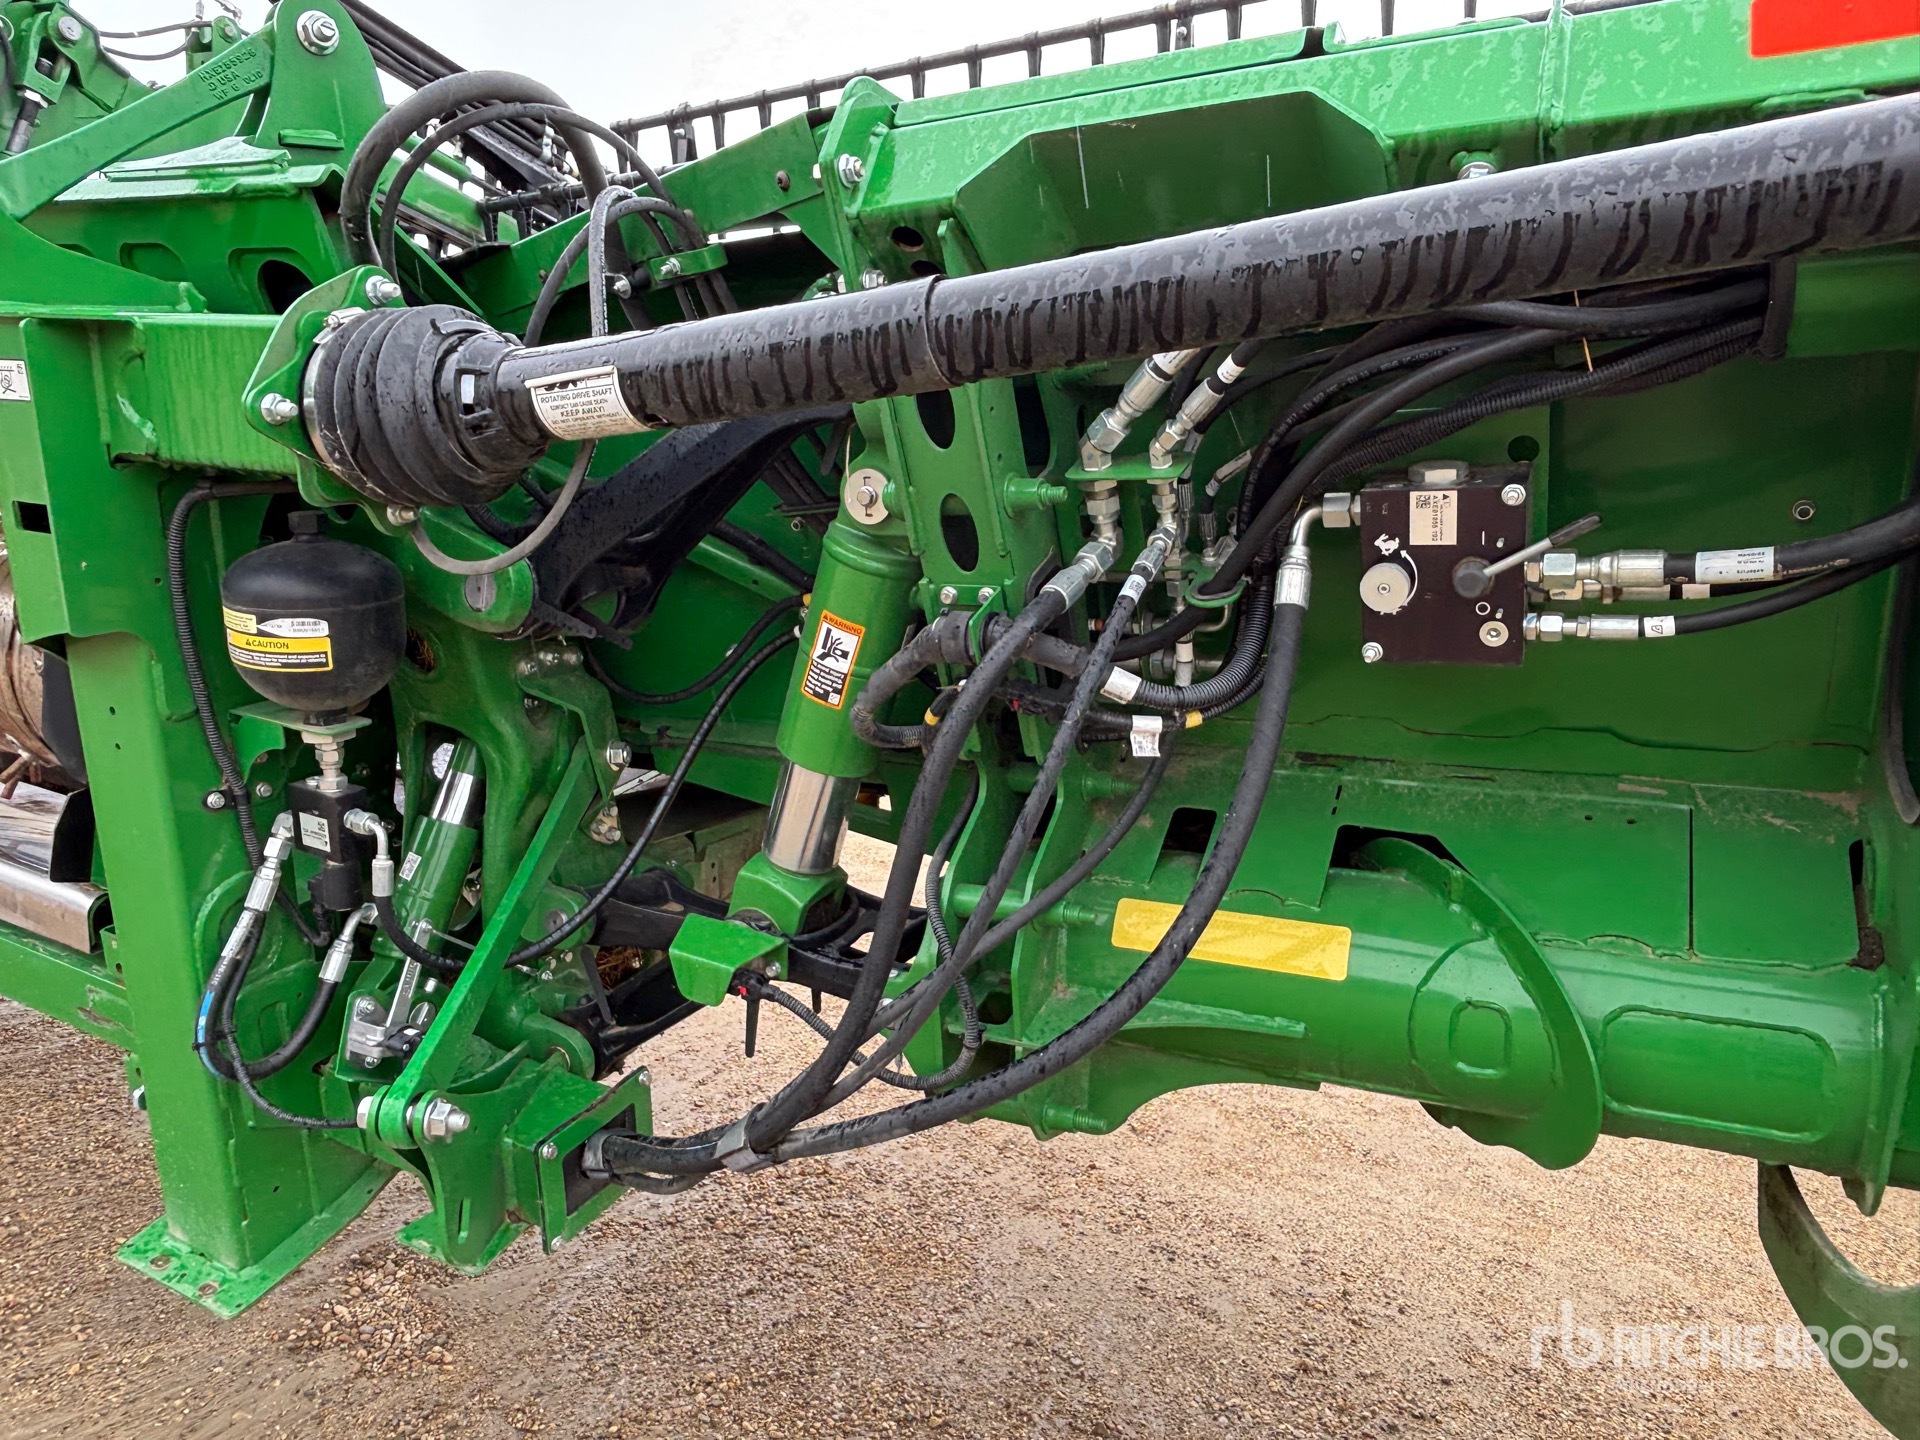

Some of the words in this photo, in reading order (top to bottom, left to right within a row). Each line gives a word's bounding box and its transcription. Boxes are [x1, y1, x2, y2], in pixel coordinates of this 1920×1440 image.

[218, 71, 240, 86] USA
[540, 393, 571, 404] ROTATING
[572, 390, 590, 400] DRIVE
[592, 387, 612, 397] SHAFT
[560, 408, 580, 417] KEEP
[828, 617, 863, 635] WARNING
[252, 641, 289, 650] CAUTION
